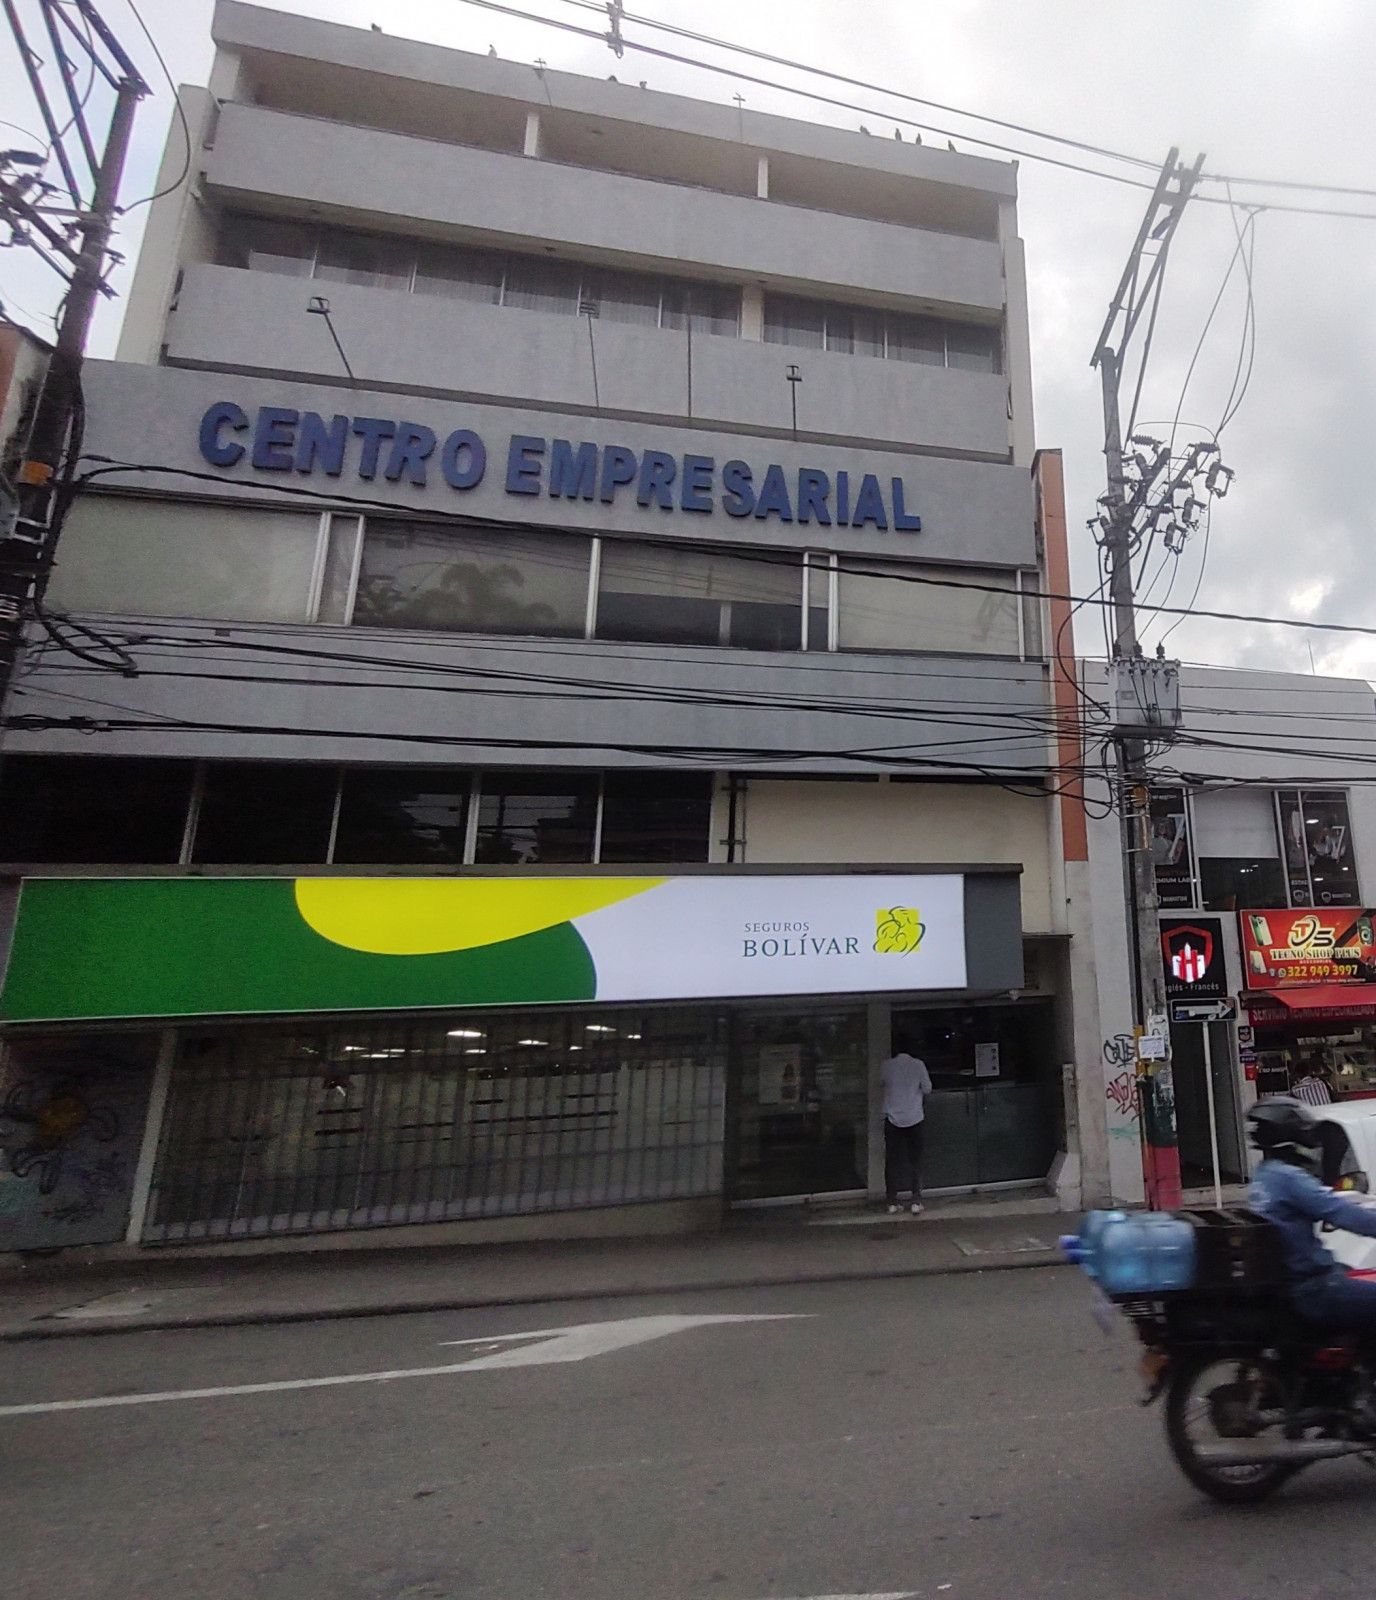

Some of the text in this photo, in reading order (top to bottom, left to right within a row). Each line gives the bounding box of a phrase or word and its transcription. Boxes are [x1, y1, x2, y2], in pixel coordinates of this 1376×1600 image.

[200, 401, 922, 532] CENTRO EMPRESARIAL
[744, 922, 810, 932] SEGUROS
[742, 933, 860, 957] BOLÍVAR
[1272, 950, 1304, 960] TECNO
[1307, 949, 1333, 959] SHOP
[1287, 964, 1358, 977] 322 949 3997
